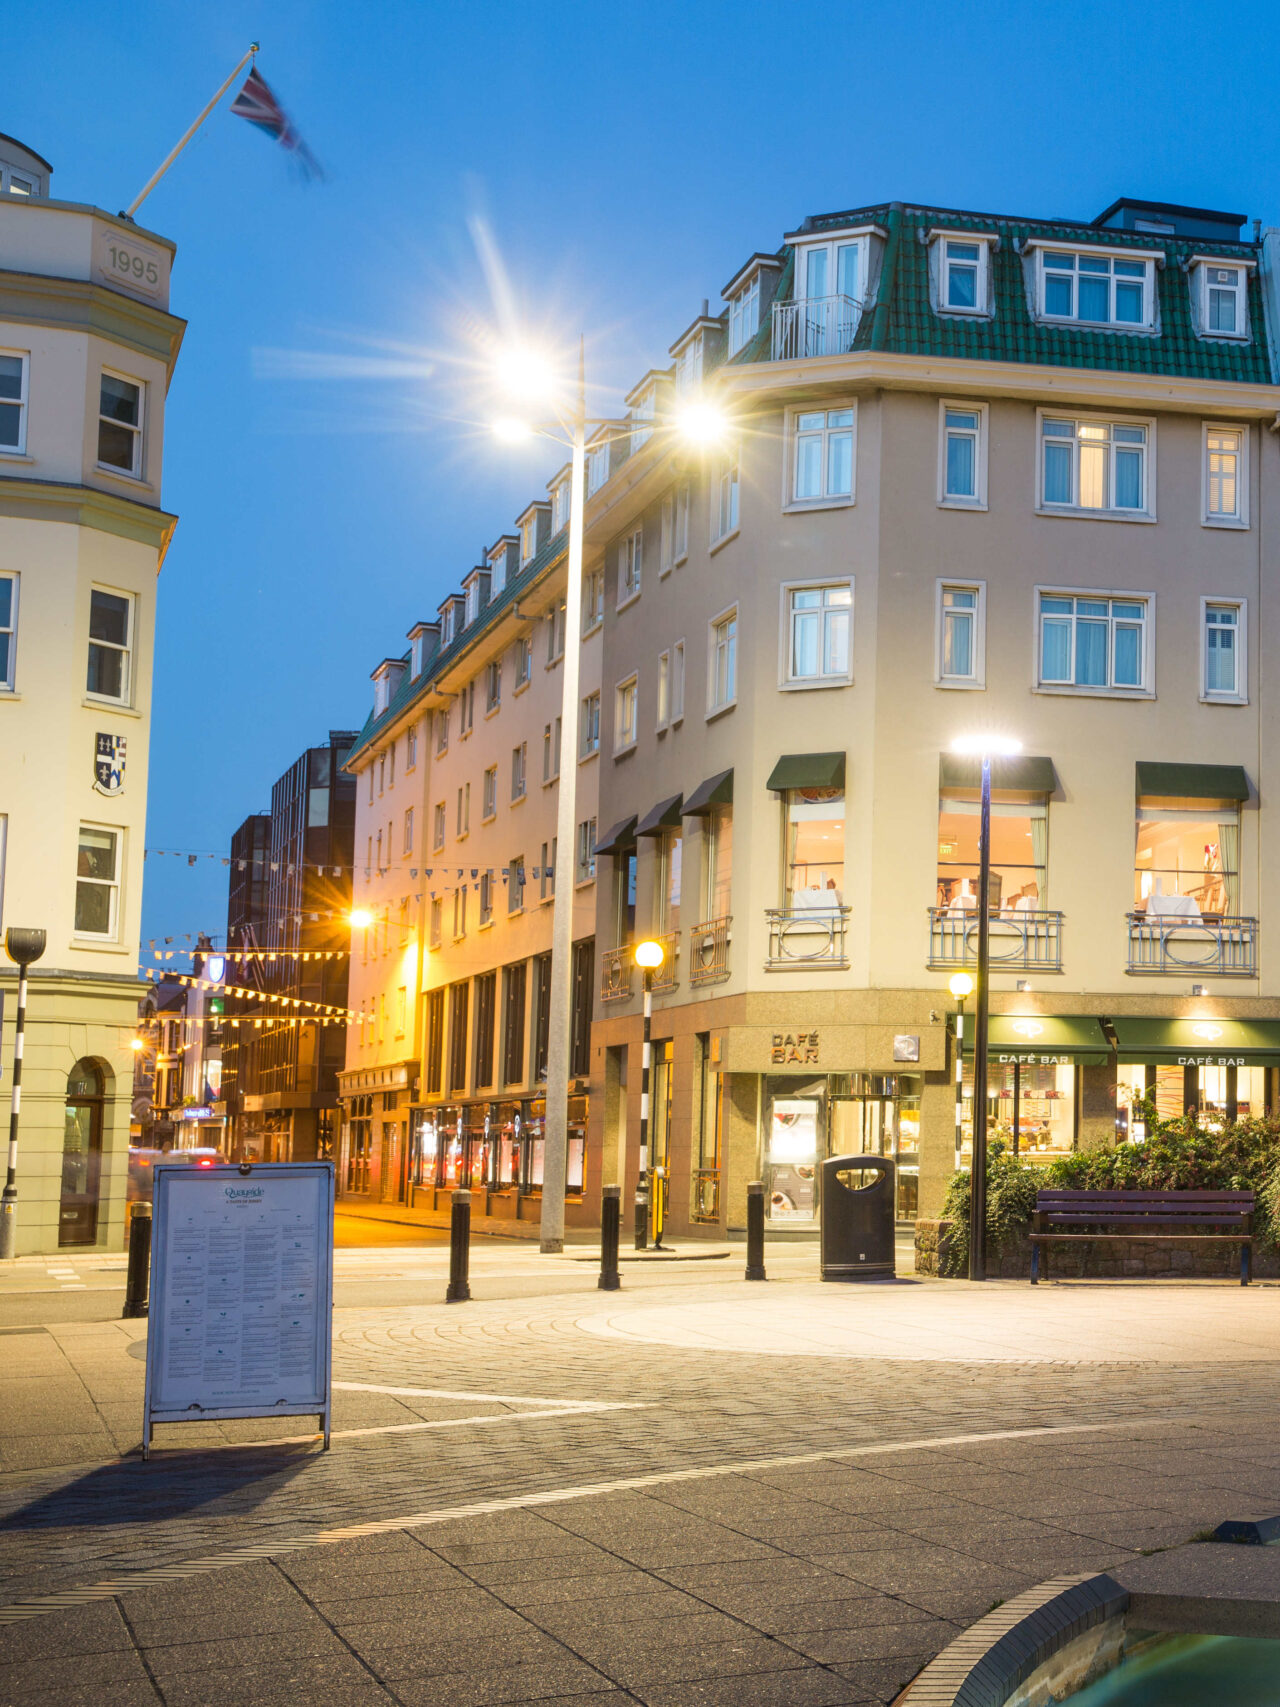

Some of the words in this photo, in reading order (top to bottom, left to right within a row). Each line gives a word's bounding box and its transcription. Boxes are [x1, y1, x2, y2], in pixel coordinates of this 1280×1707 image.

[109, 246, 158, 284] 1995
[772, 1030, 819, 1048] CAFÉ
[771, 1047, 819, 1065] BAR
[999, 1053, 1036, 1064] CAFÉ
[1040, 1055, 1069, 1064] BAR
[1177, 1055, 1214, 1066] CAFÉ
[1217, 1057, 1245, 1066] BAR
